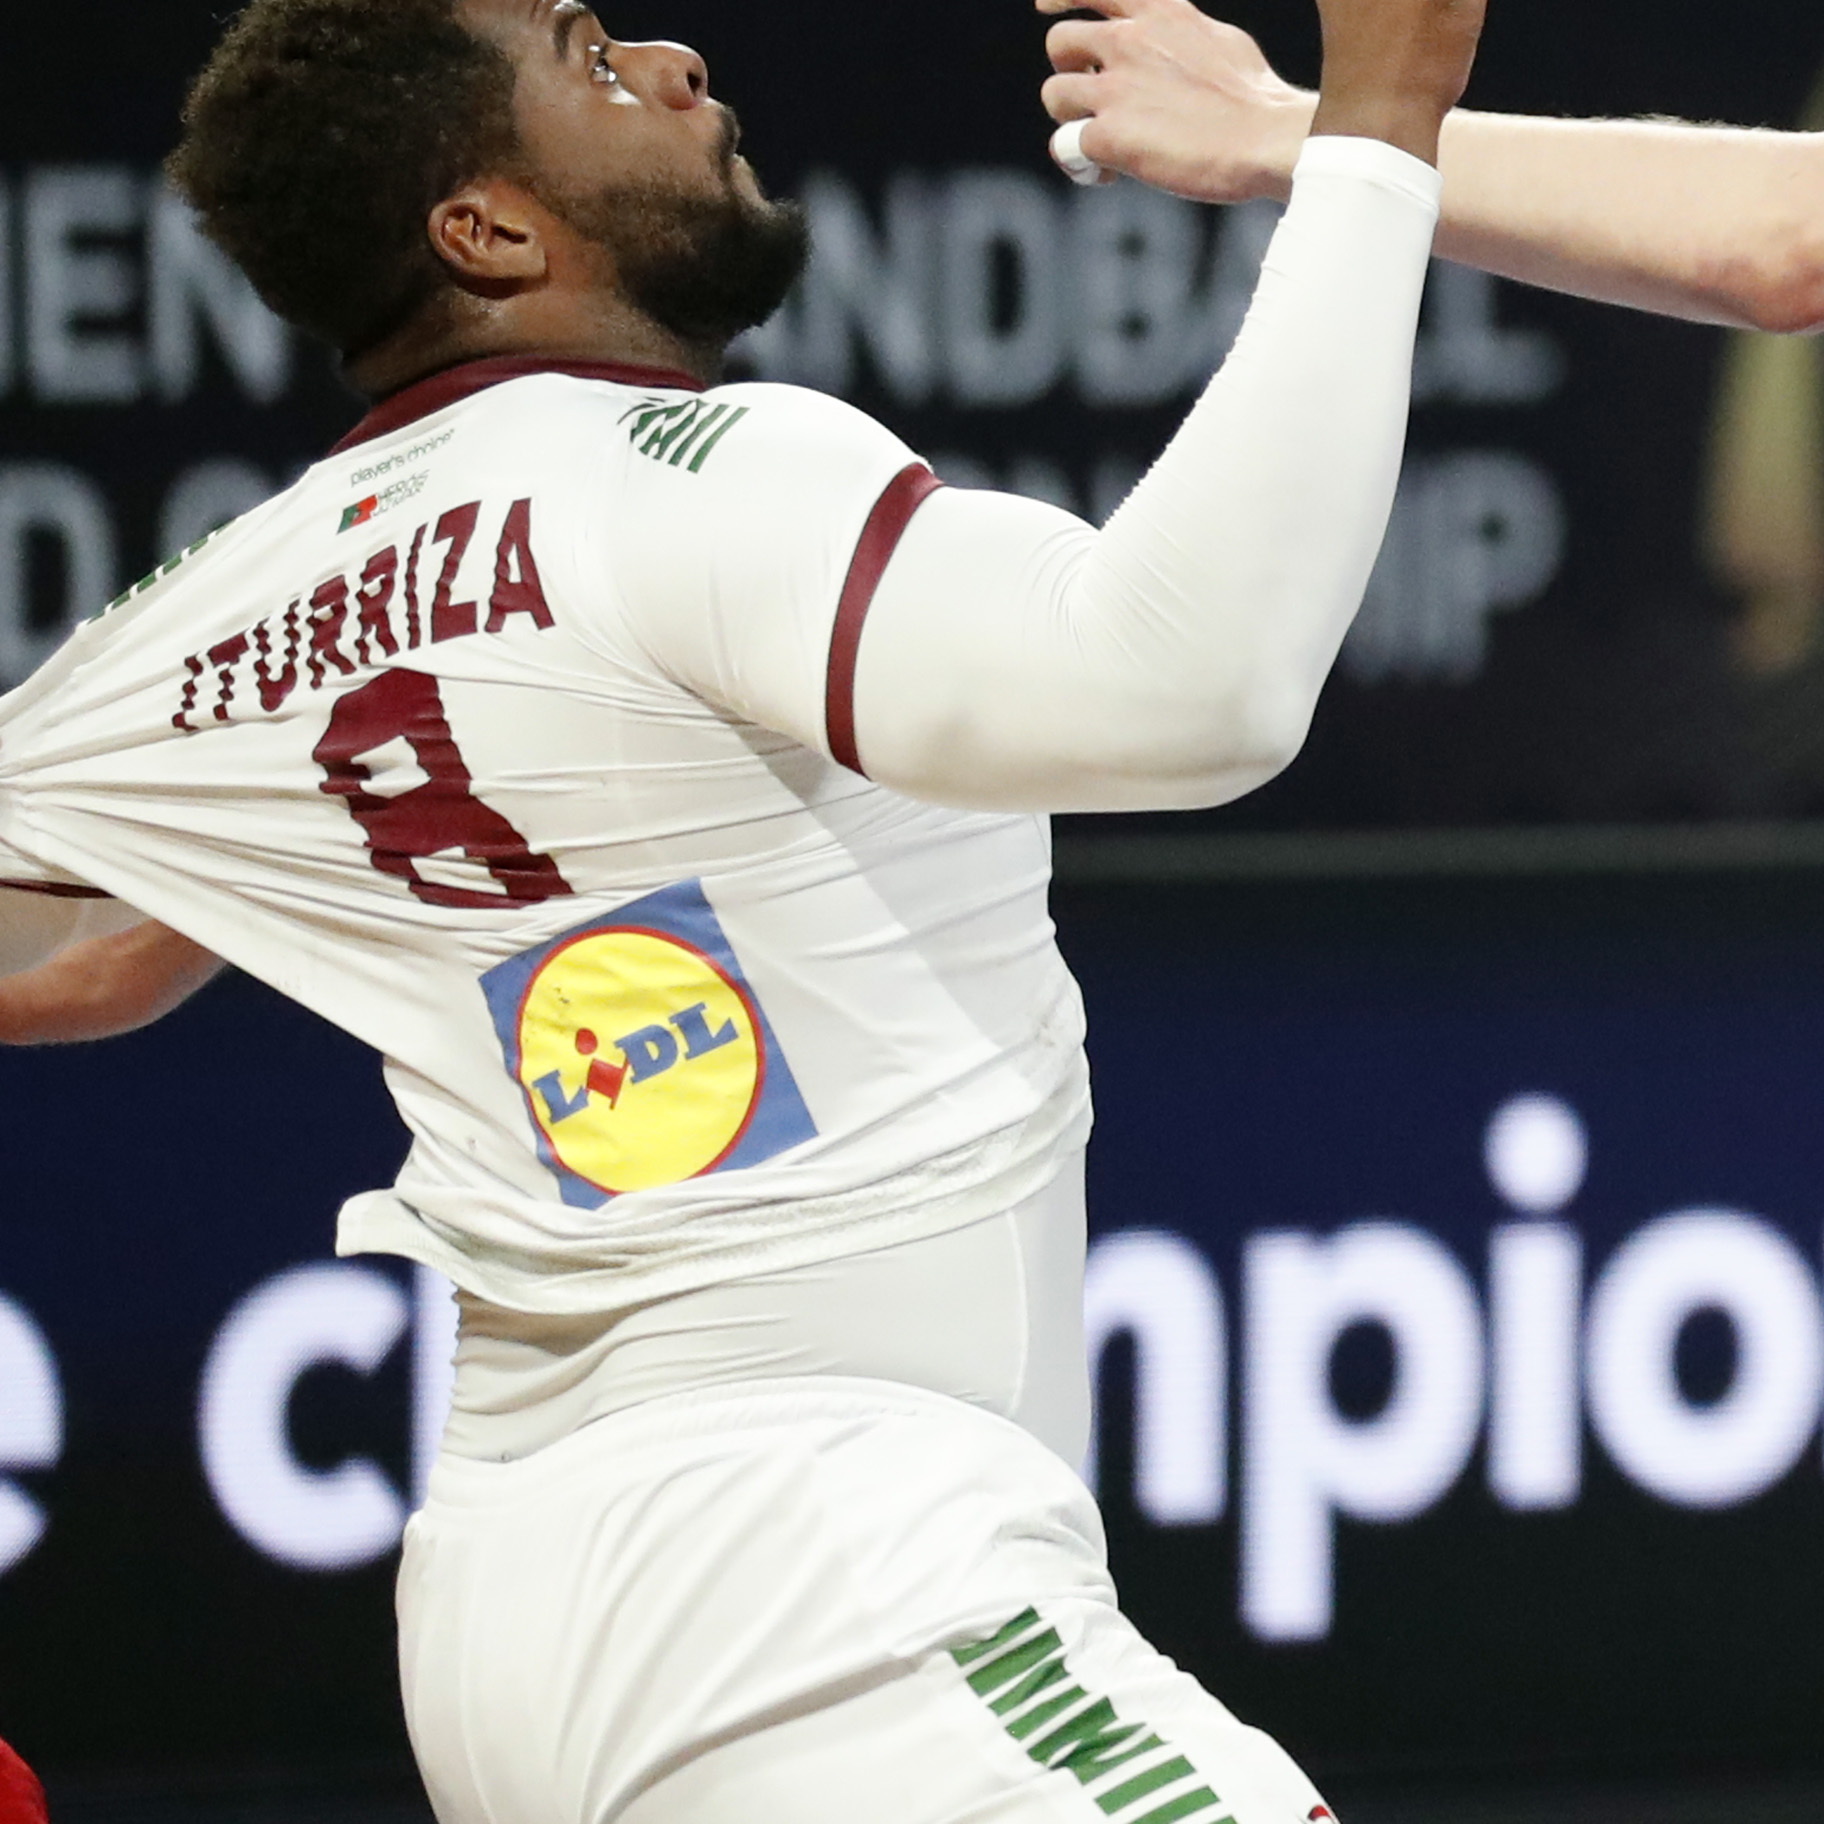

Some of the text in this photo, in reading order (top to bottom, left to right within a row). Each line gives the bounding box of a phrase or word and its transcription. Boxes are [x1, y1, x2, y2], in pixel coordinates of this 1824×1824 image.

[0, 164, 290, 406] EN
[171, 496, 556, 731] ITURRIZA
[312, 667, 575, 910] 8
